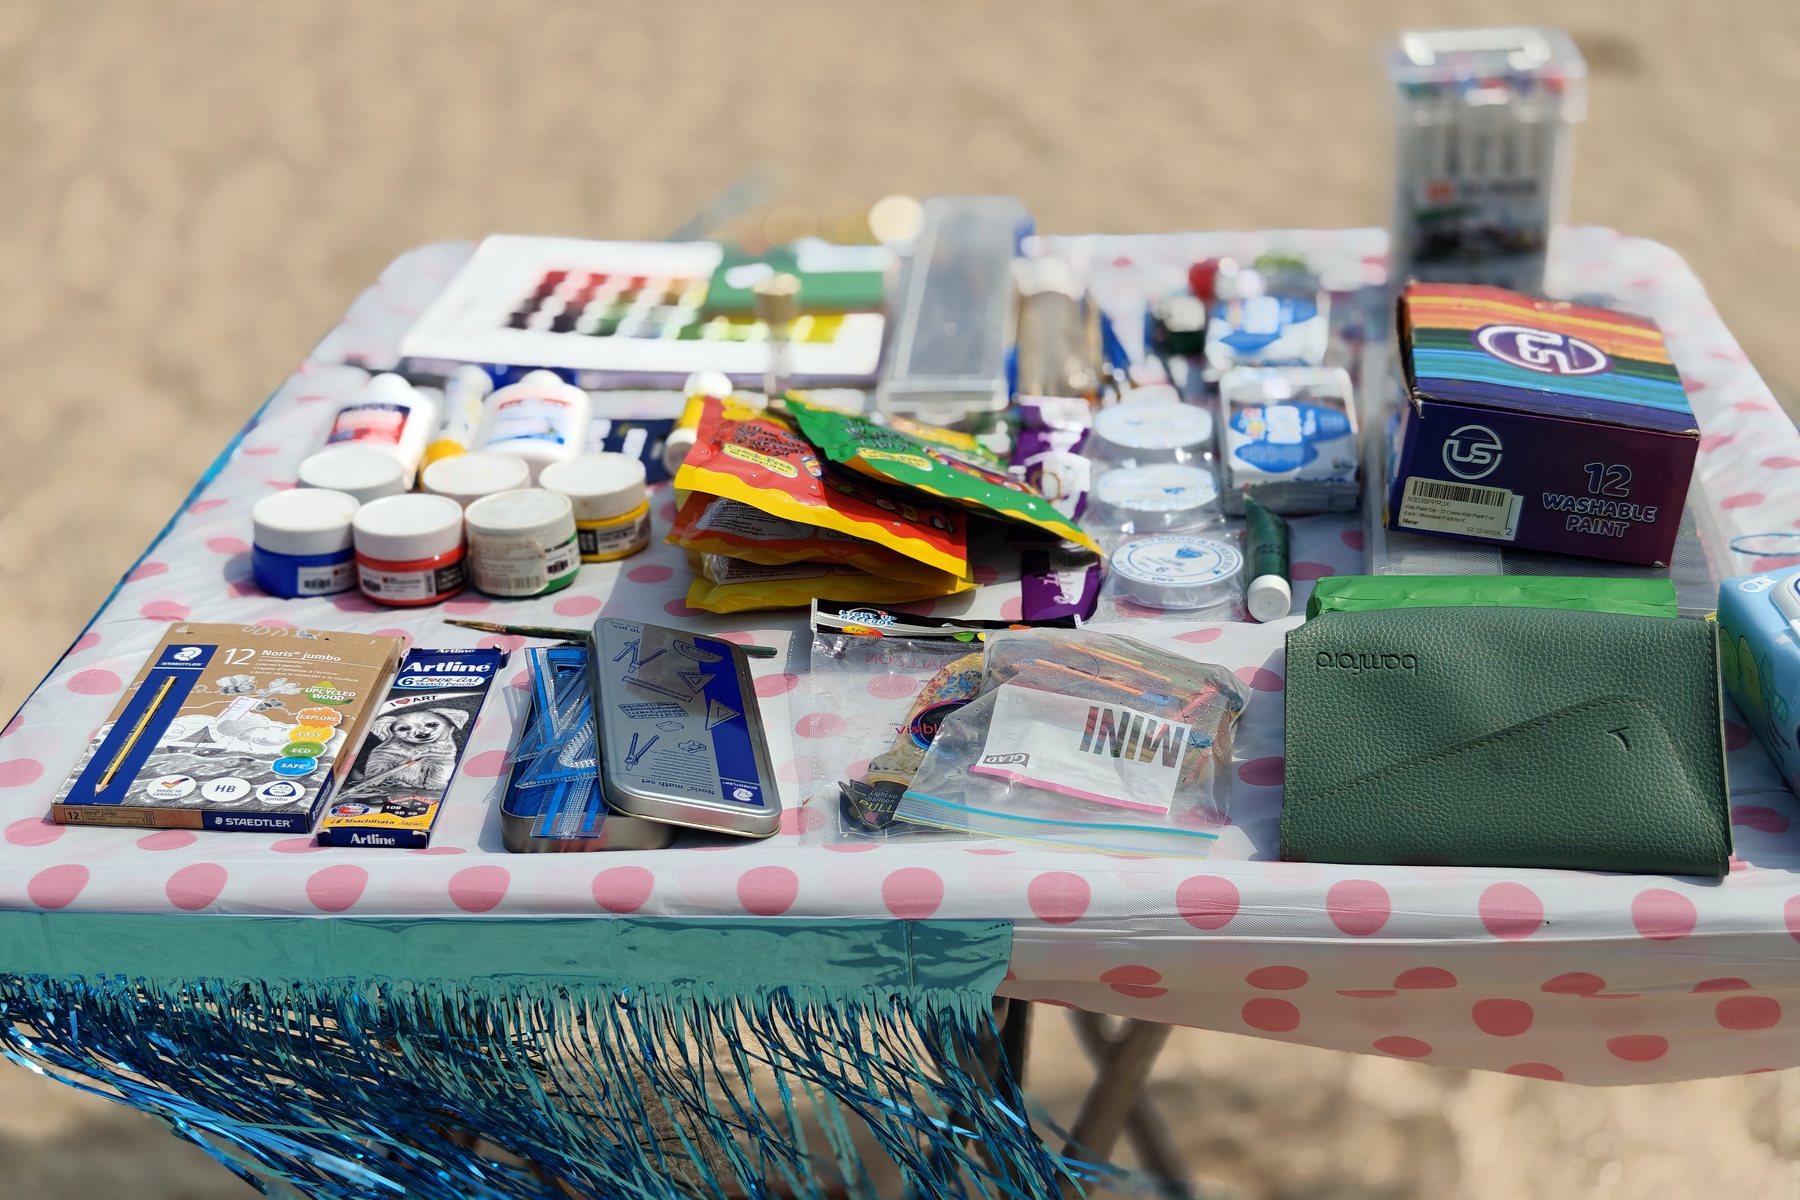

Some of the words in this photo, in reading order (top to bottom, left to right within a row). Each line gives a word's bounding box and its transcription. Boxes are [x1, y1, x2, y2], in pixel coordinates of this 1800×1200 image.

[1583, 463, 1632, 497] 12
[1542, 492, 1658, 522] WASHABLE
[1566, 514, 1630, 538] PAINT
[224, 648, 256, 666] 12
[301, 652, 342, 662] jumbo
[402, 662, 490, 672] Artline
[1316, 652, 1418, 676] bamford
[402, 678, 415, 686] 6
[305, 688, 356, 697] UPCYCLED
[1078, 705, 1186, 768] MINI
[986, 753, 1026, 764] GLAD
[215, 784, 237, 793] HB
[859, 800, 895, 813] PULL
[68, 812, 79, 820] 12
[226, 817, 291, 828] STAEDTLER
[350, 833, 396, 846] Artline
